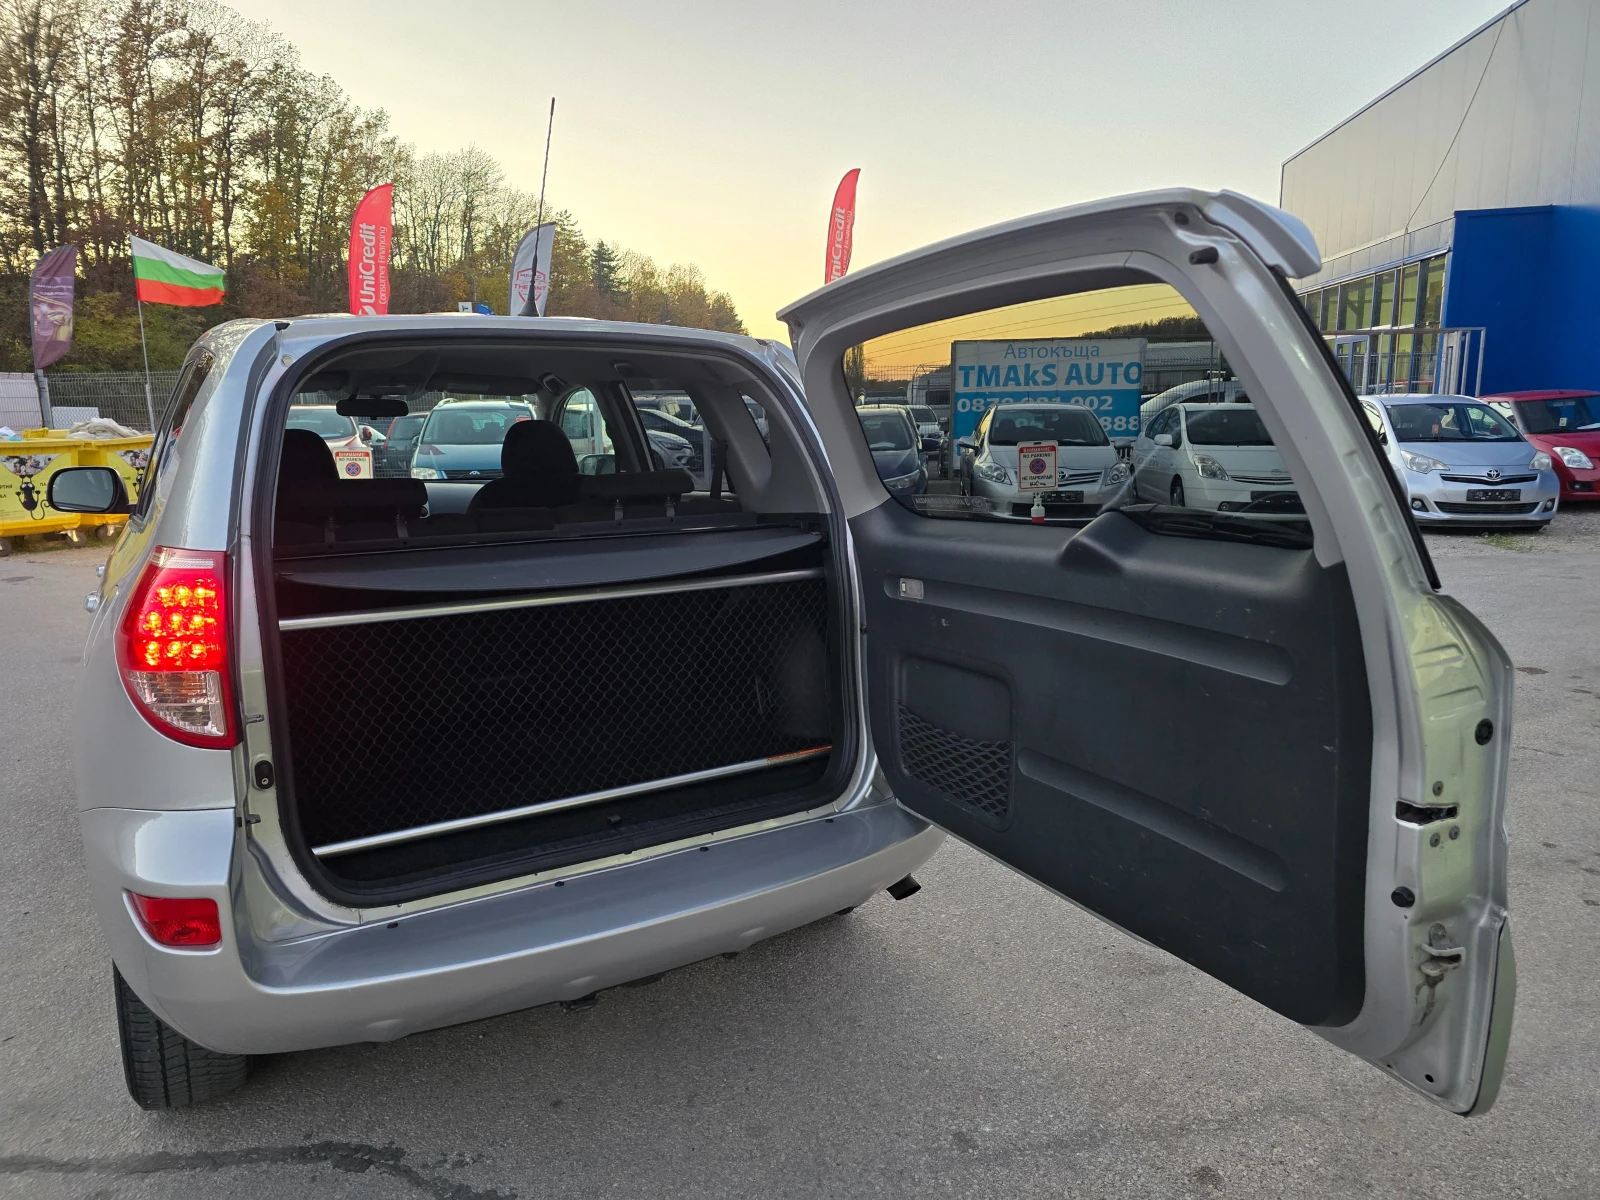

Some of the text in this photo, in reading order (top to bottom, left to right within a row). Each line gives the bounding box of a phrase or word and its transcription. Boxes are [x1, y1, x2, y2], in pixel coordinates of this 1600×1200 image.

[359, 222, 376, 304] UniCredit
[378, 226, 388, 305] Consumer Financing
[958, 361, 1142, 388] TMAkS AUTO
[1004, 343, 1100, 360] Автокъща
